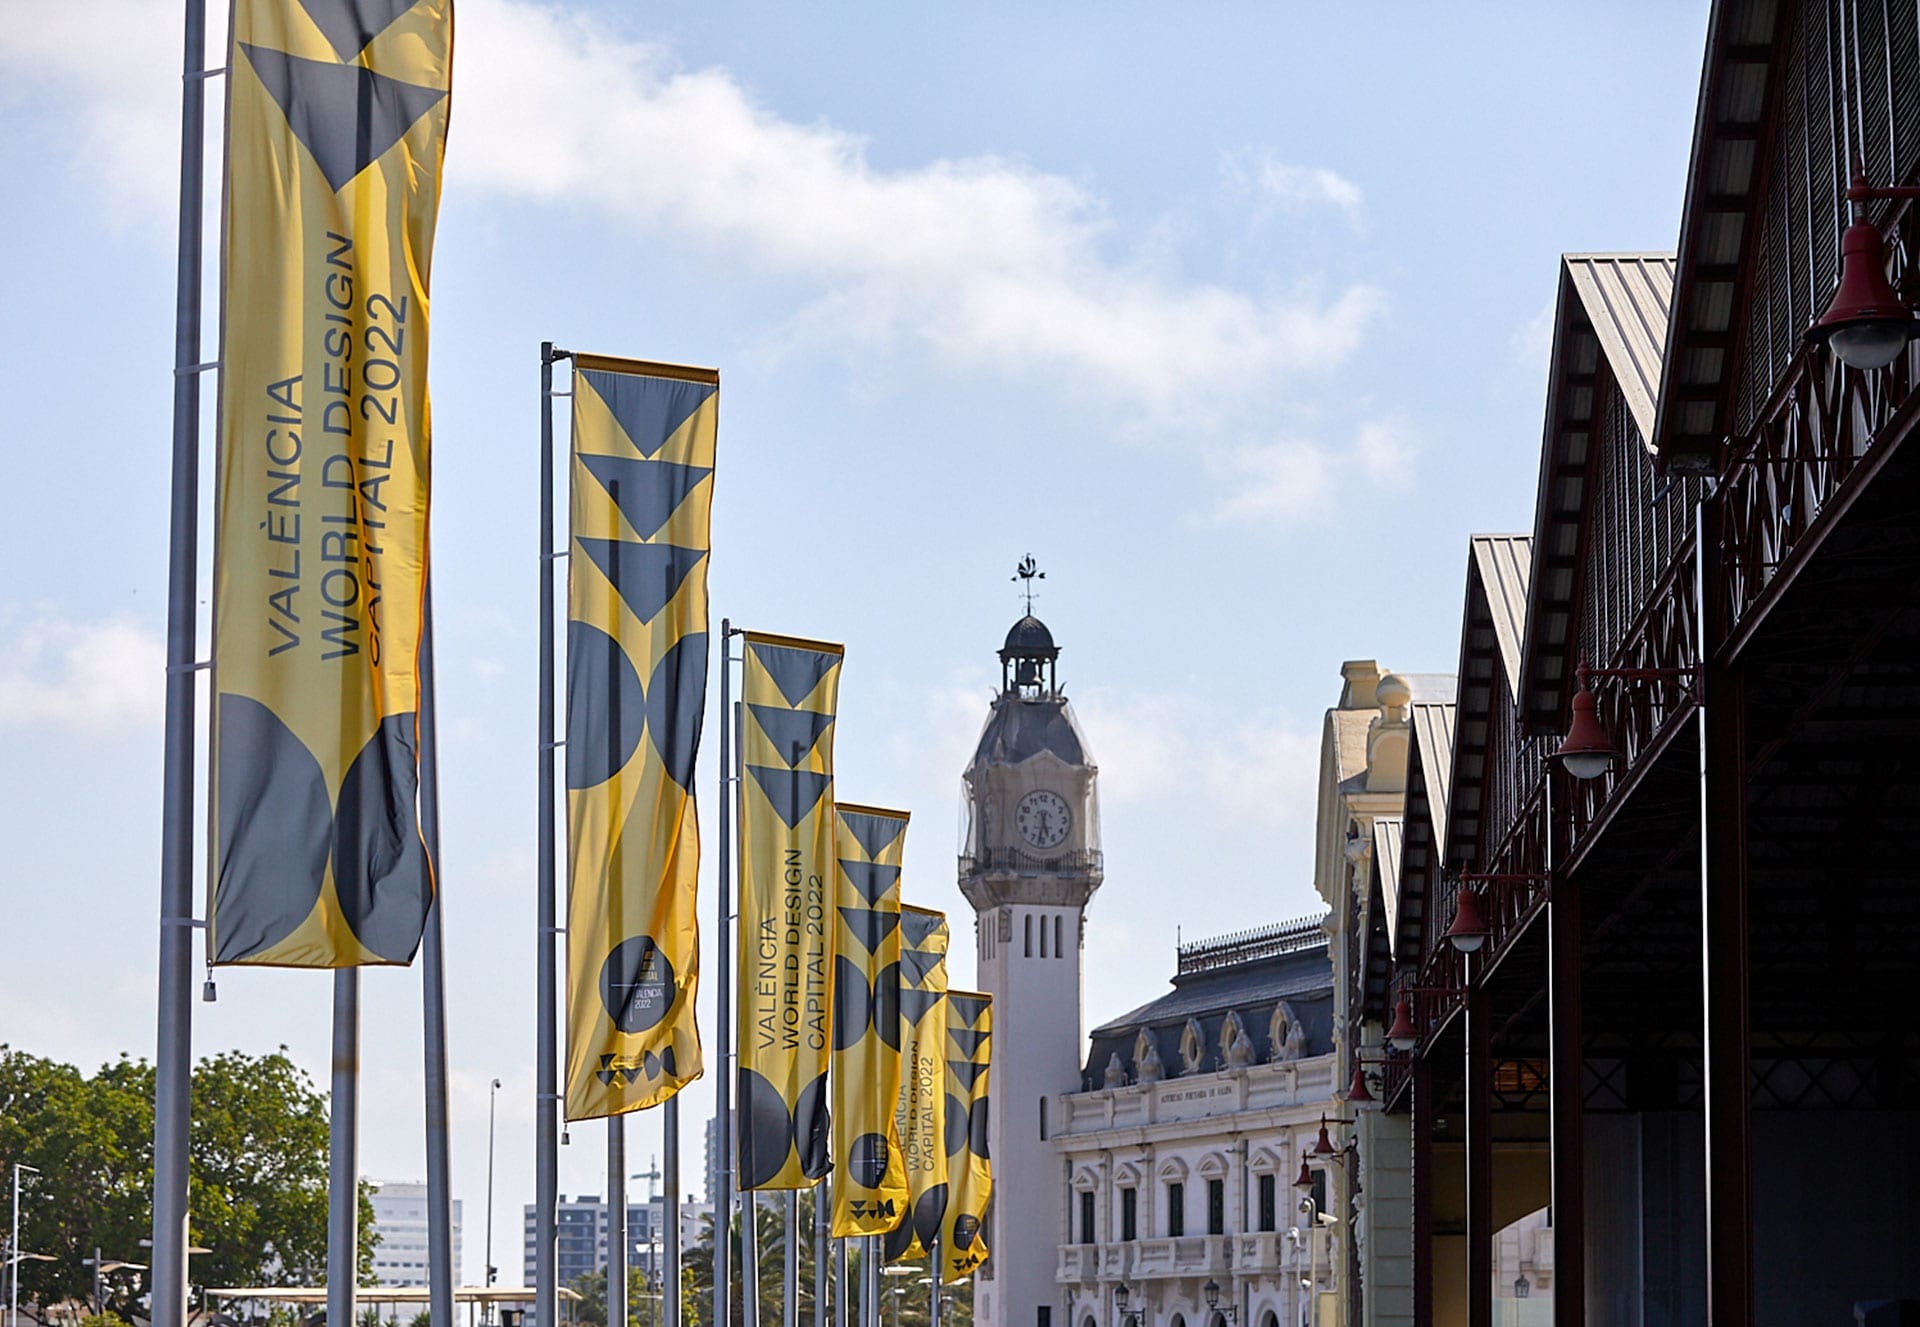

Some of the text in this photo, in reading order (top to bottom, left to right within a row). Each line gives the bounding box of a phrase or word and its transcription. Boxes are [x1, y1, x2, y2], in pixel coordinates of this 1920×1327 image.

[260, 374, 303, 657] VALÈNCIA
[321, 231, 360, 660] WORLD DESIGN
[358, 293, 407, 667] CAPITAL 2022
[634, 999, 652, 1009] 2022
[755, 917, 777, 1049] VALÈNCIA
[782, 849, 803, 1050] WORLD DESIGN
[807, 875, 825, 1050] CAPITAL 2022
[908, 1040, 919, 1171] WORLD DESIGN
[920, 1057, 935, 1171] CAPITAL 2022
